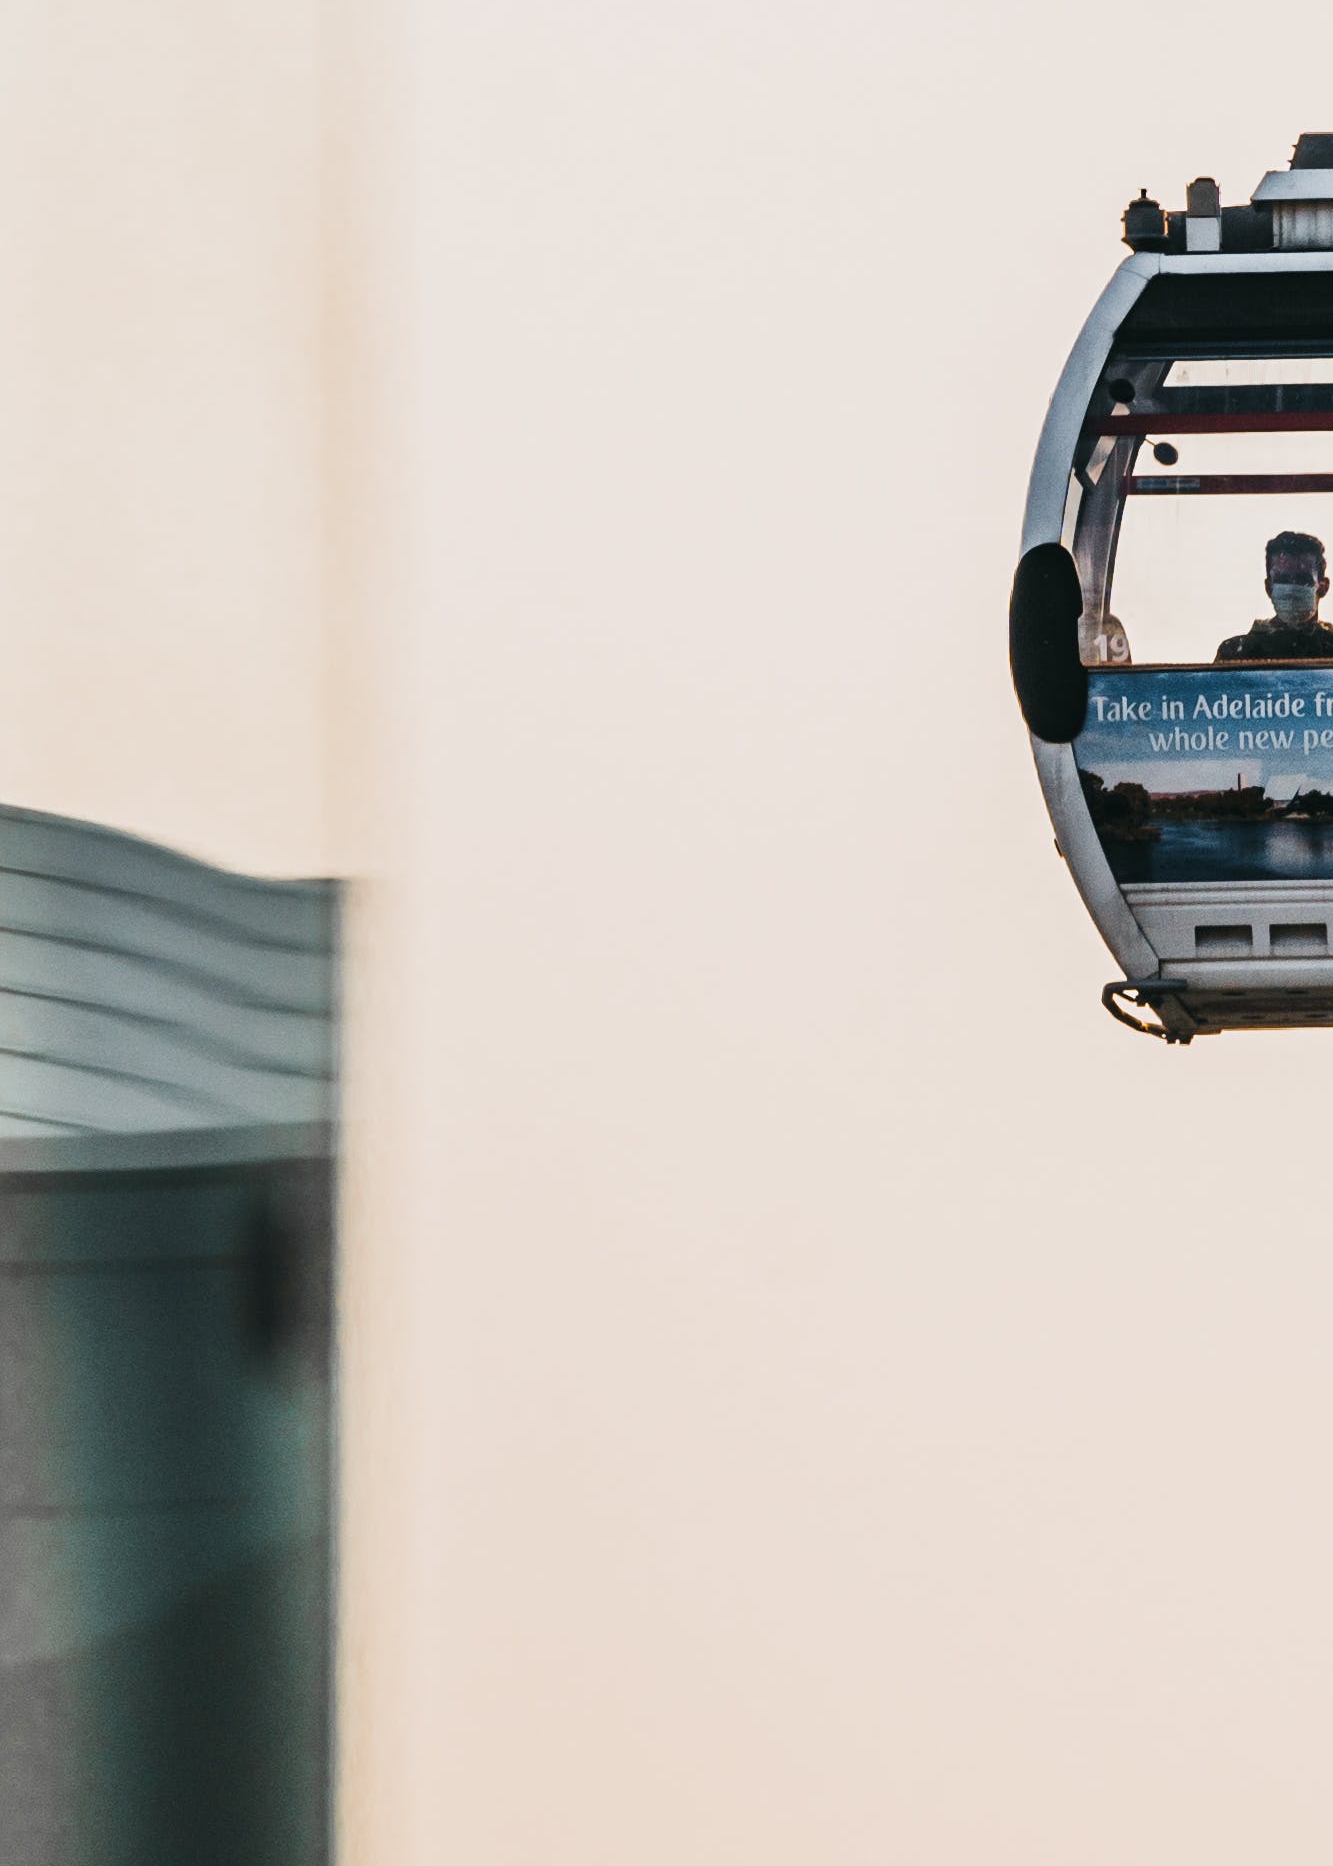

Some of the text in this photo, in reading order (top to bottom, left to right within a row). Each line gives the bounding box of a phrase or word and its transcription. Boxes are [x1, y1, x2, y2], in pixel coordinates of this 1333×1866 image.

[1093, 633, 1130, 662] 19
[1090, 695, 1151, 722] Take
[1161, 694, 1185, 721] in
[1192, 691, 1306, 720] Adelaide
[1148, 726, 1229, 752] whole
[1238, 730, 1295, 750] new
